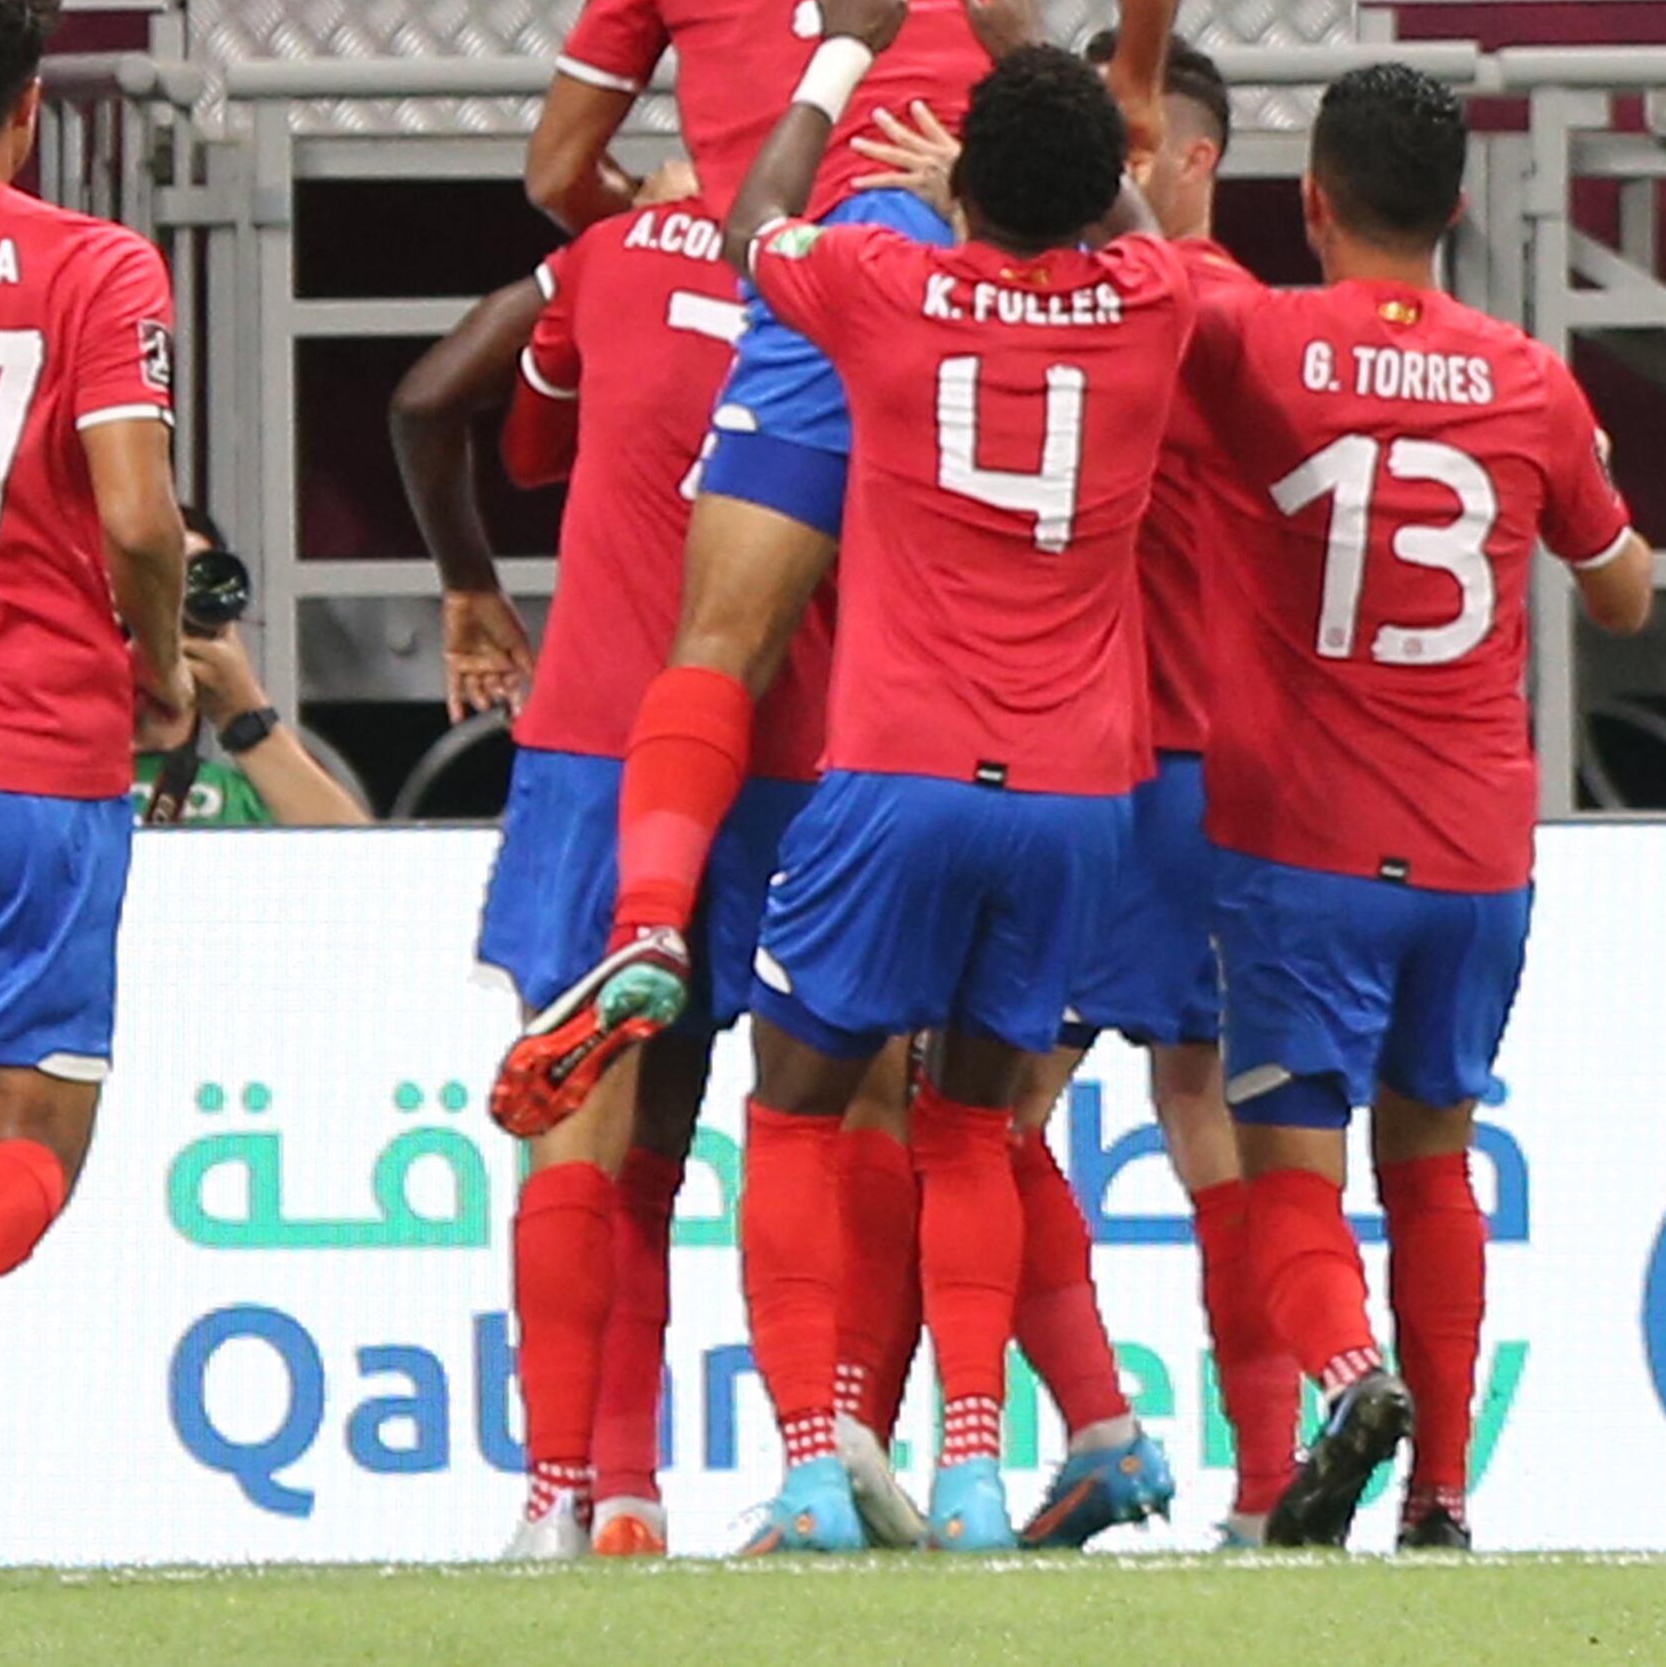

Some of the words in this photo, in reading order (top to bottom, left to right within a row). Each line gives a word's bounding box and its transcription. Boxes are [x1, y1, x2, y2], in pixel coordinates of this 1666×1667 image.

[624, 211, 724, 263] A.CO
[923, 272, 964, 321] K.
[973, 282, 1123, 327] FULLER
[1303, 340, 1341, 392] G.
[1353, 345, 1494, 405] TORRES
[936, 355, 1086, 555] 4
[1267, 432, 1500, 667] 13
